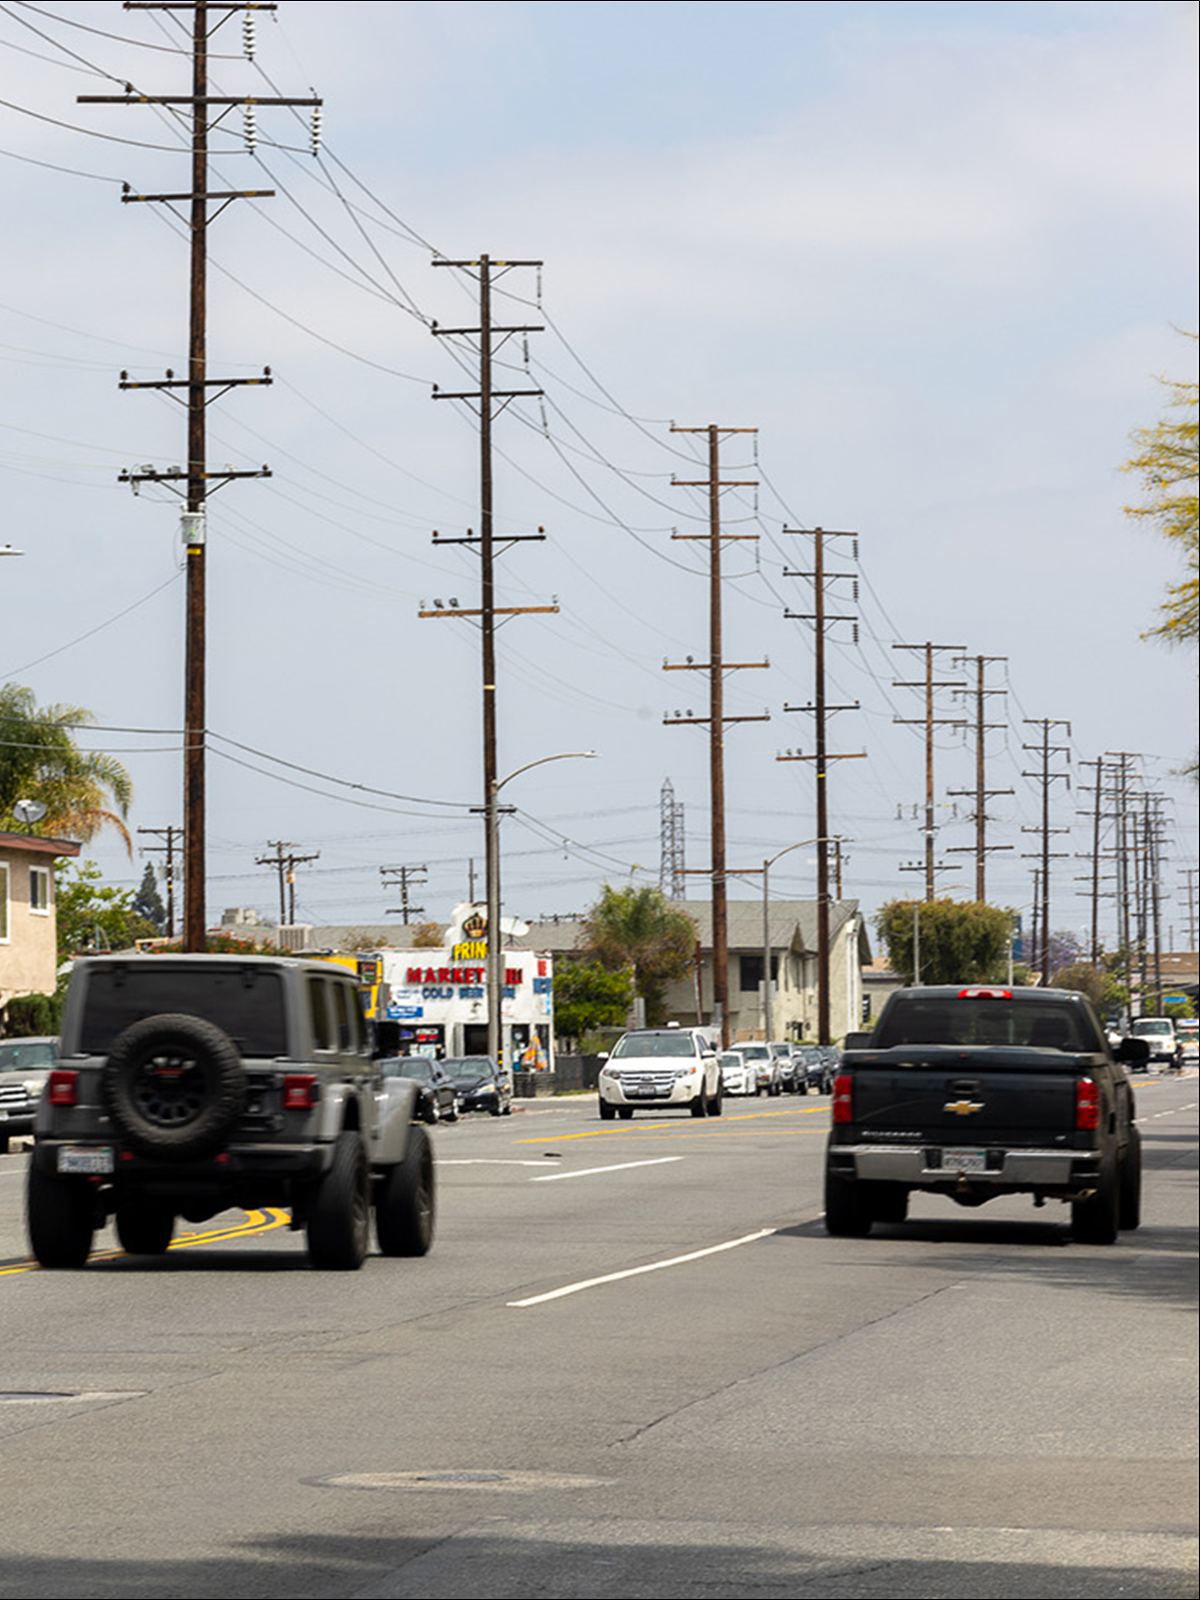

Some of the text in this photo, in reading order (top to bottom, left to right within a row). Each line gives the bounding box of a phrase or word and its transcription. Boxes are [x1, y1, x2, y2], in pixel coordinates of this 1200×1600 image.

[453, 941, 488, 961] PRIN
[406, 967, 485, 984] MARKET
[422, 987, 454, 1000] COLD
